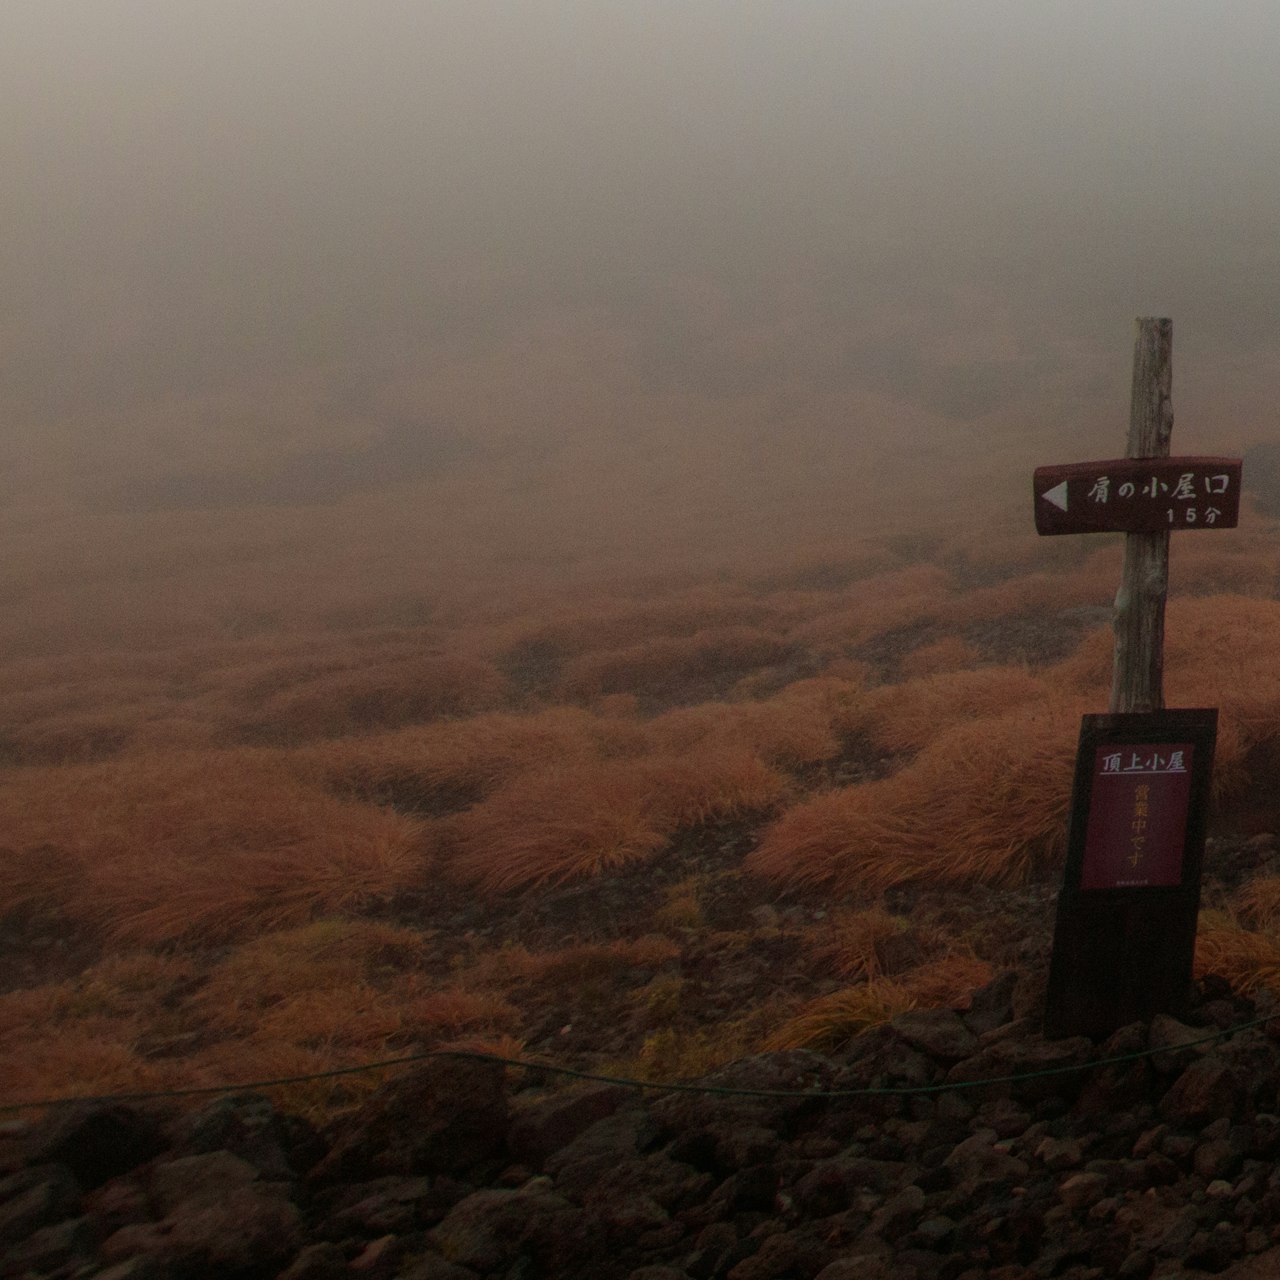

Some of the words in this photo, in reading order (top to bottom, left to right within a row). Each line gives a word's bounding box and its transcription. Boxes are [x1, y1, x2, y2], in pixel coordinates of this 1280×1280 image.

[1087, 472, 1230, 503] 肩の小屋口
[1166, 507, 1221, 524] 15分
[1102, 751, 1186, 771] 頂上小屋
[1127, 784, 1150, 868] 営業中です
